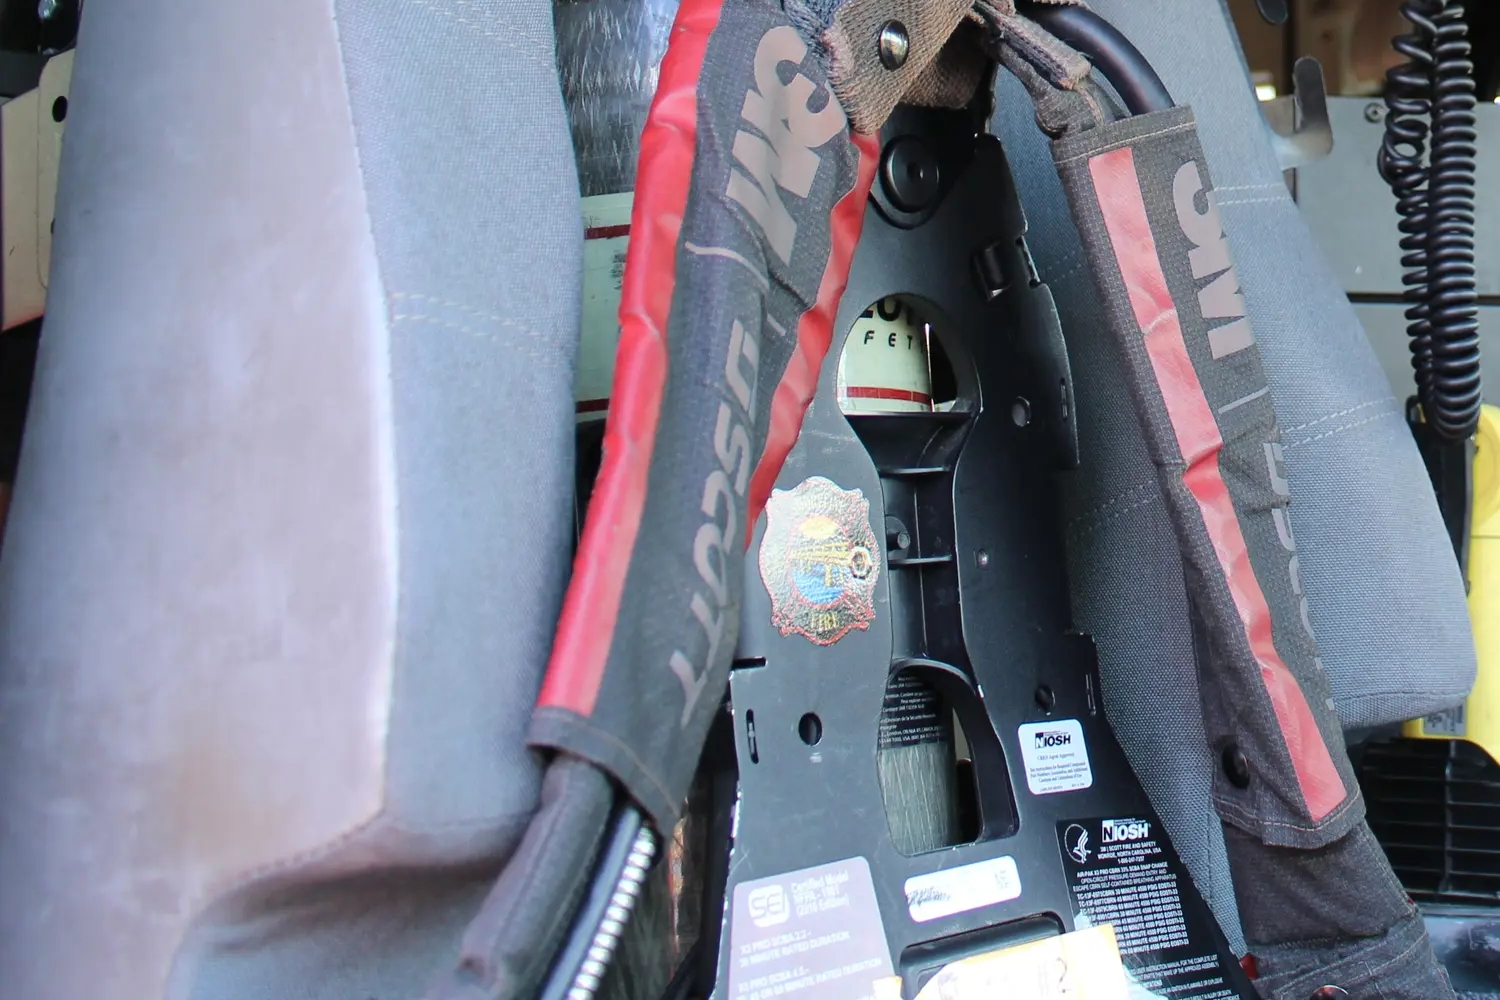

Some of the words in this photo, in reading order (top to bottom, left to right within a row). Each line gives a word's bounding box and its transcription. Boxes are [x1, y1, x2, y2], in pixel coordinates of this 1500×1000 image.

[725, 25, 848, 266] 3M
[1172, 160, 1254, 360] 3M
[1035, 732, 1071, 749] NIOSH
[1102, 819, 1149, 843] NIOSH
